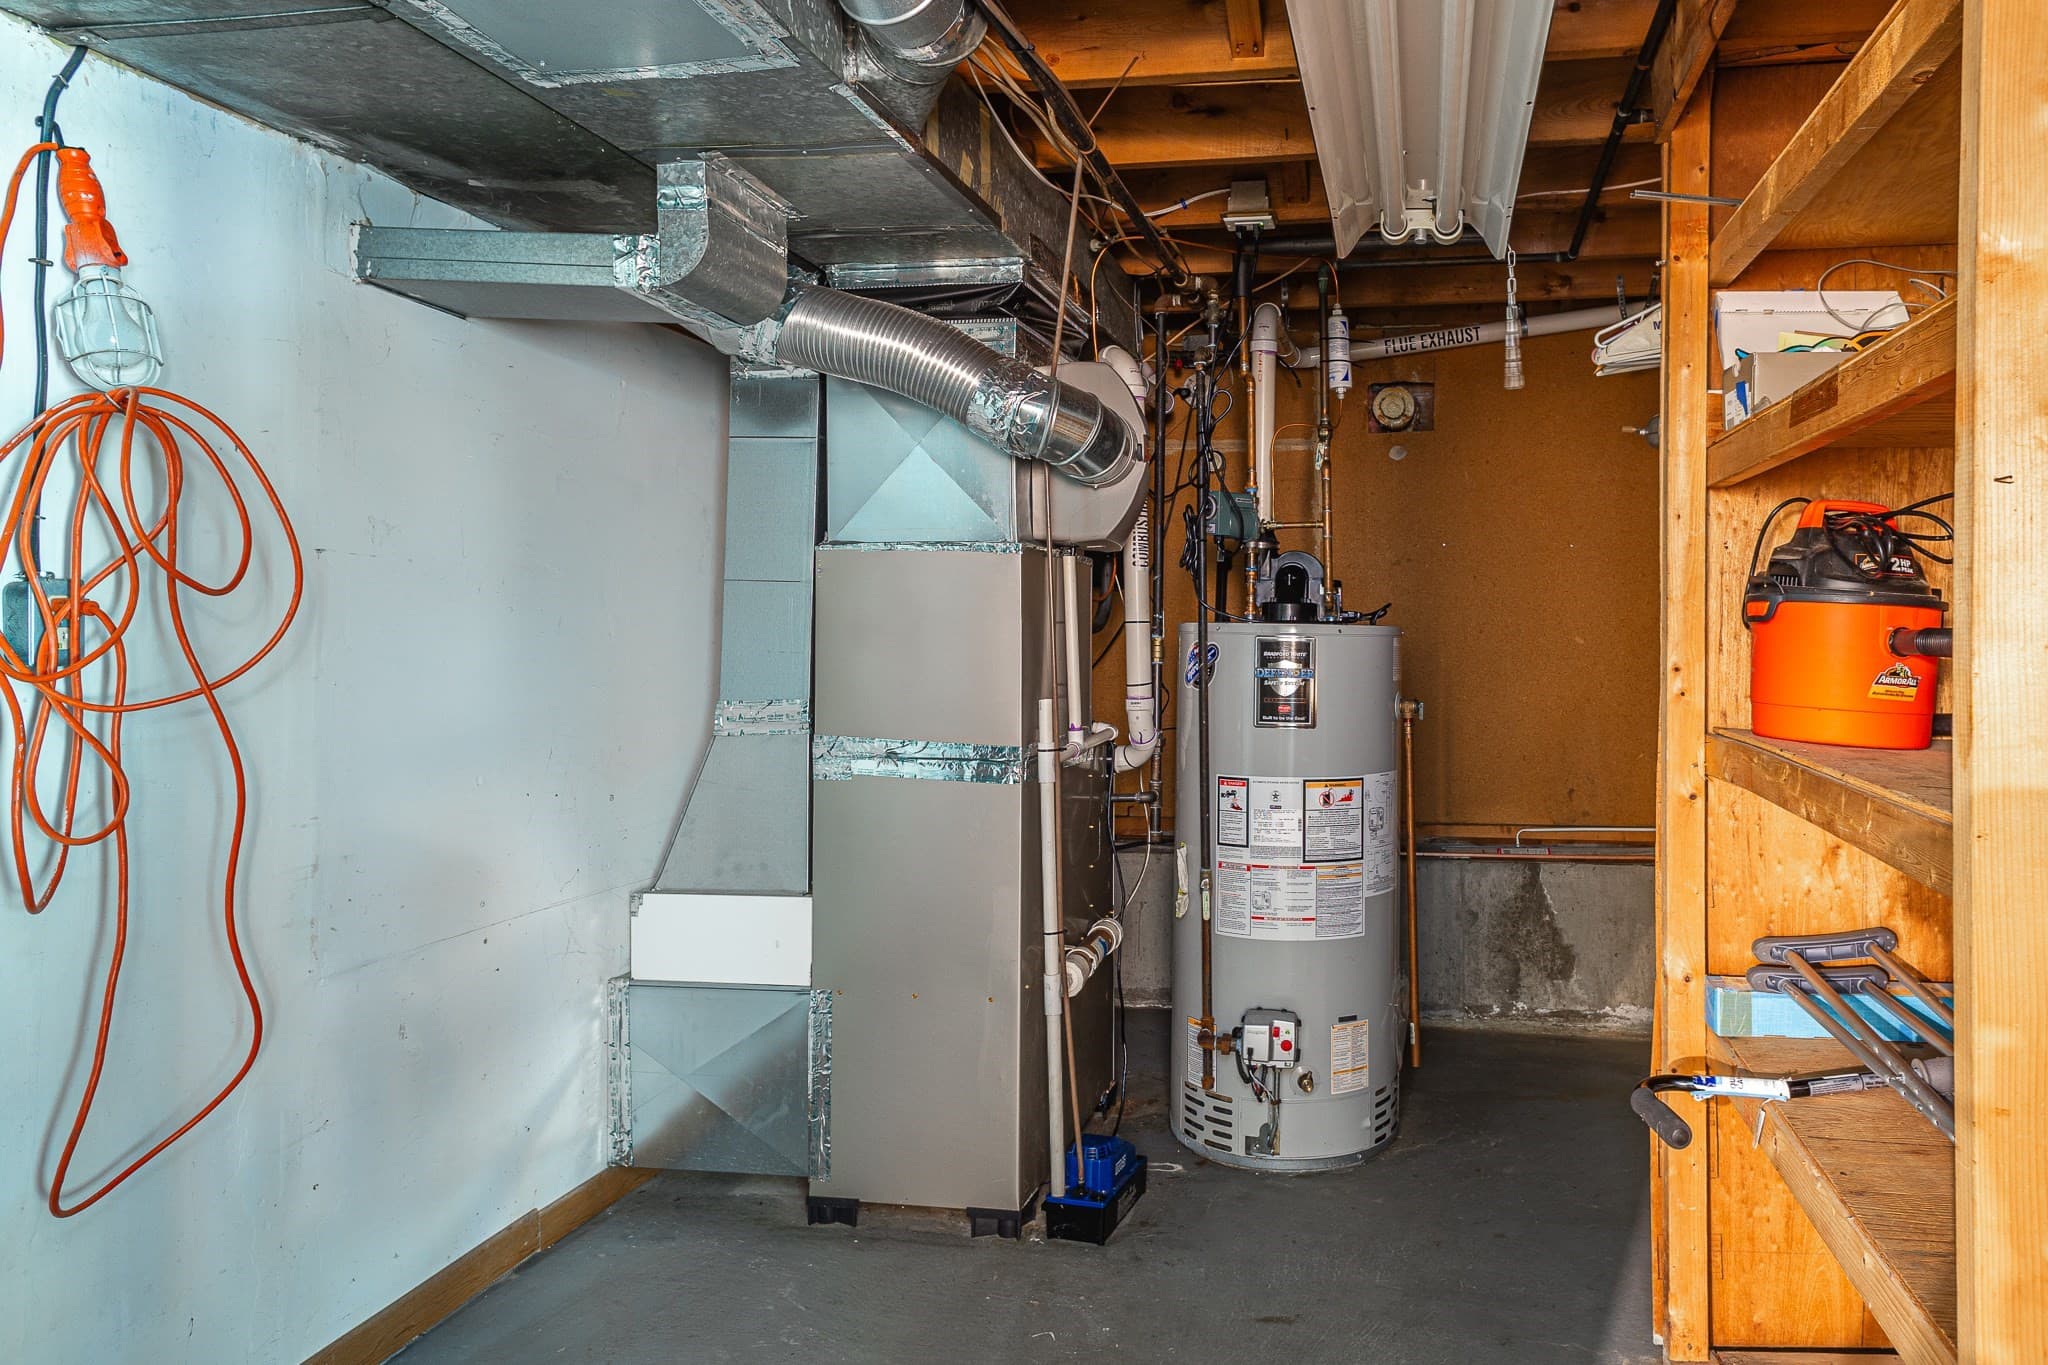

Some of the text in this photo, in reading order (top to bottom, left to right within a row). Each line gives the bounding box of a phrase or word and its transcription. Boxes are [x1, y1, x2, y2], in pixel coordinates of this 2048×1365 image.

[1384, 326, 1481, 354] FLUE EXHAUST
[1890, 557, 1901, 571] 2
[1900, 558, 1911, 568] HP
